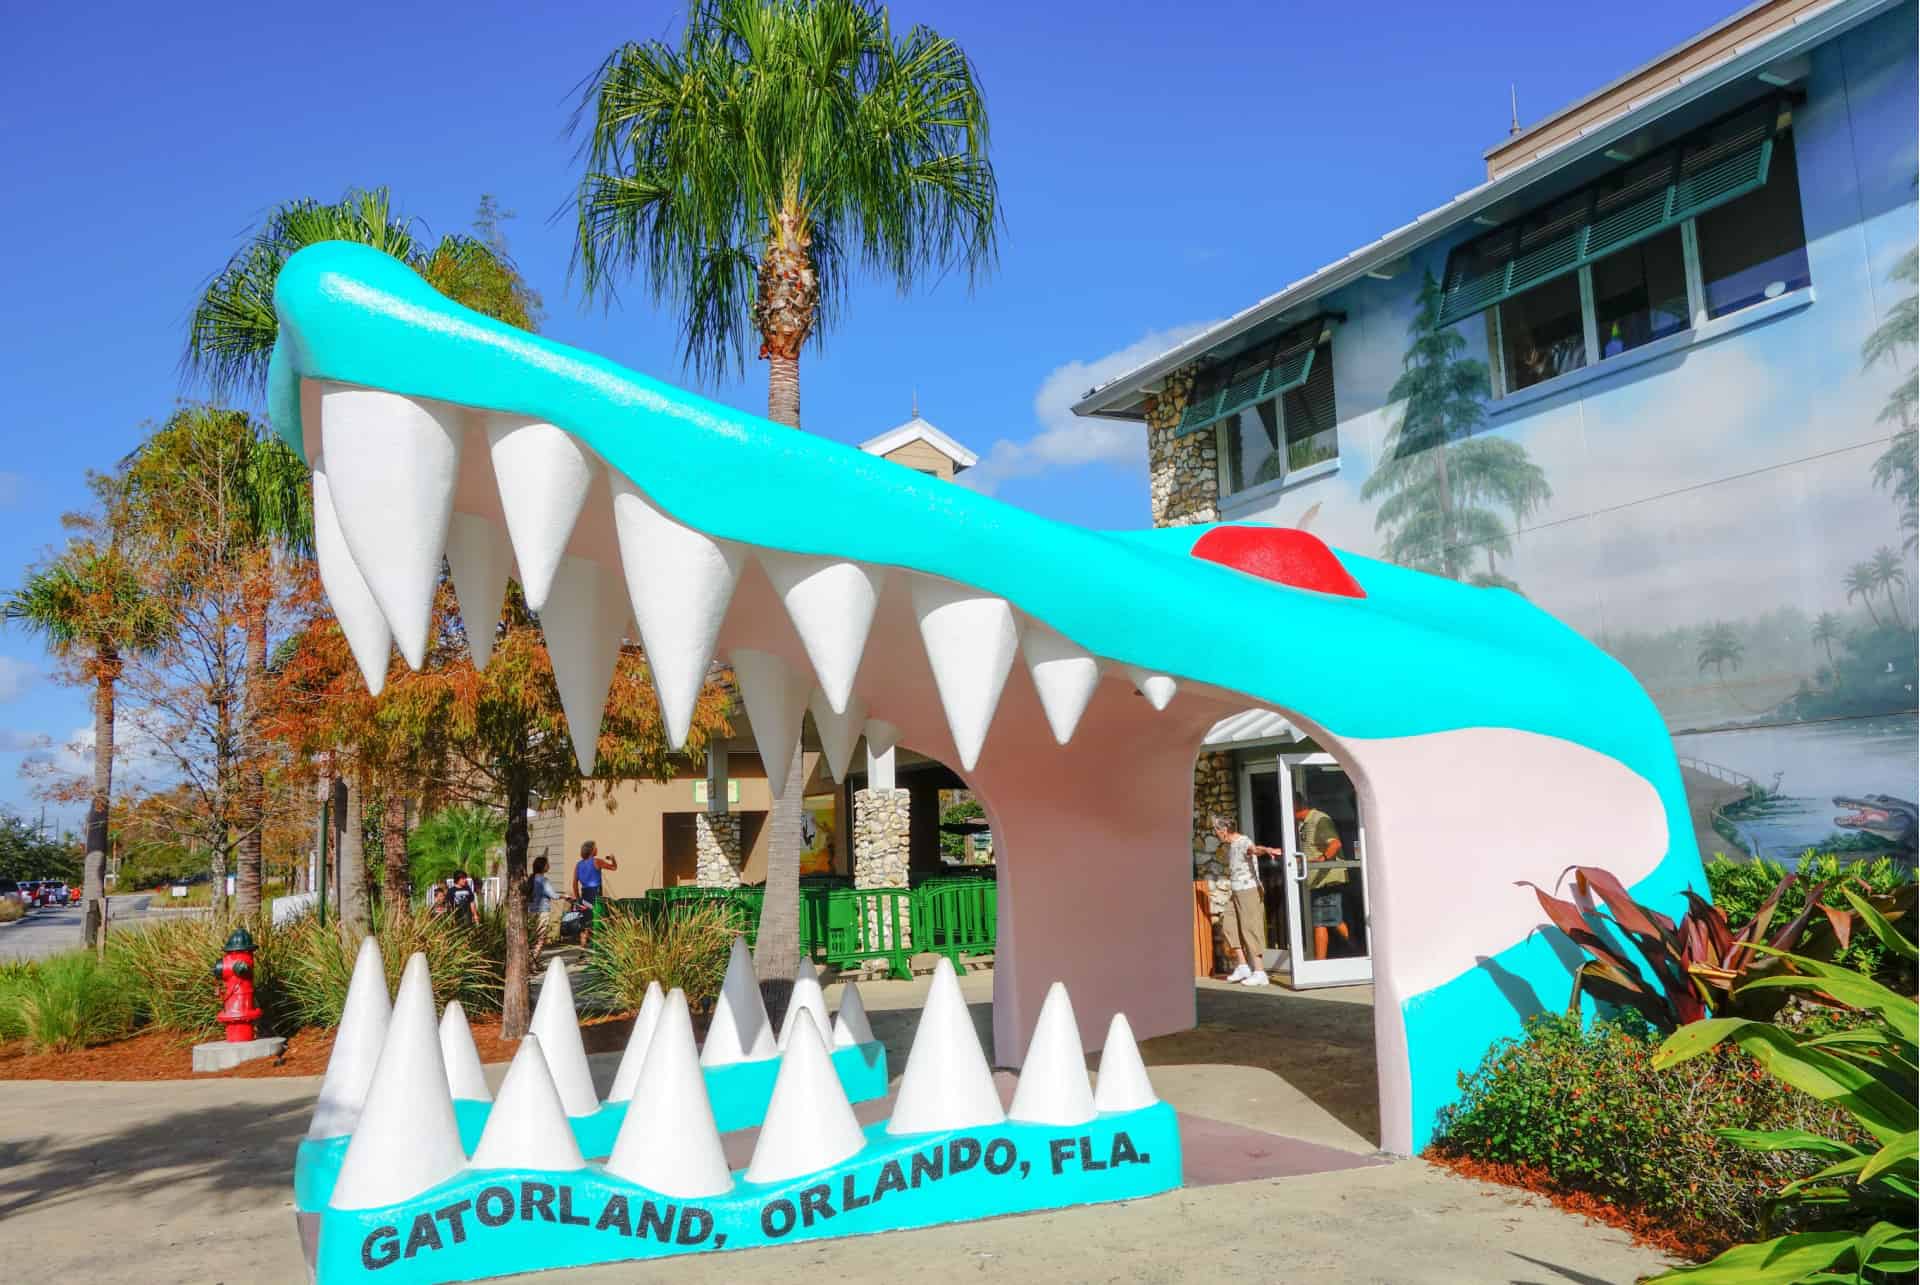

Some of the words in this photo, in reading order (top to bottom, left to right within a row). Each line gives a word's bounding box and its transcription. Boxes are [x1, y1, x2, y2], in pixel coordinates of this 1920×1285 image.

[361, 1181, 728, 1271] GATORLAND,
[760, 1136, 1031, 1239] ORLANDO,
[1048, 1131, 1151, 1175] FLA.
